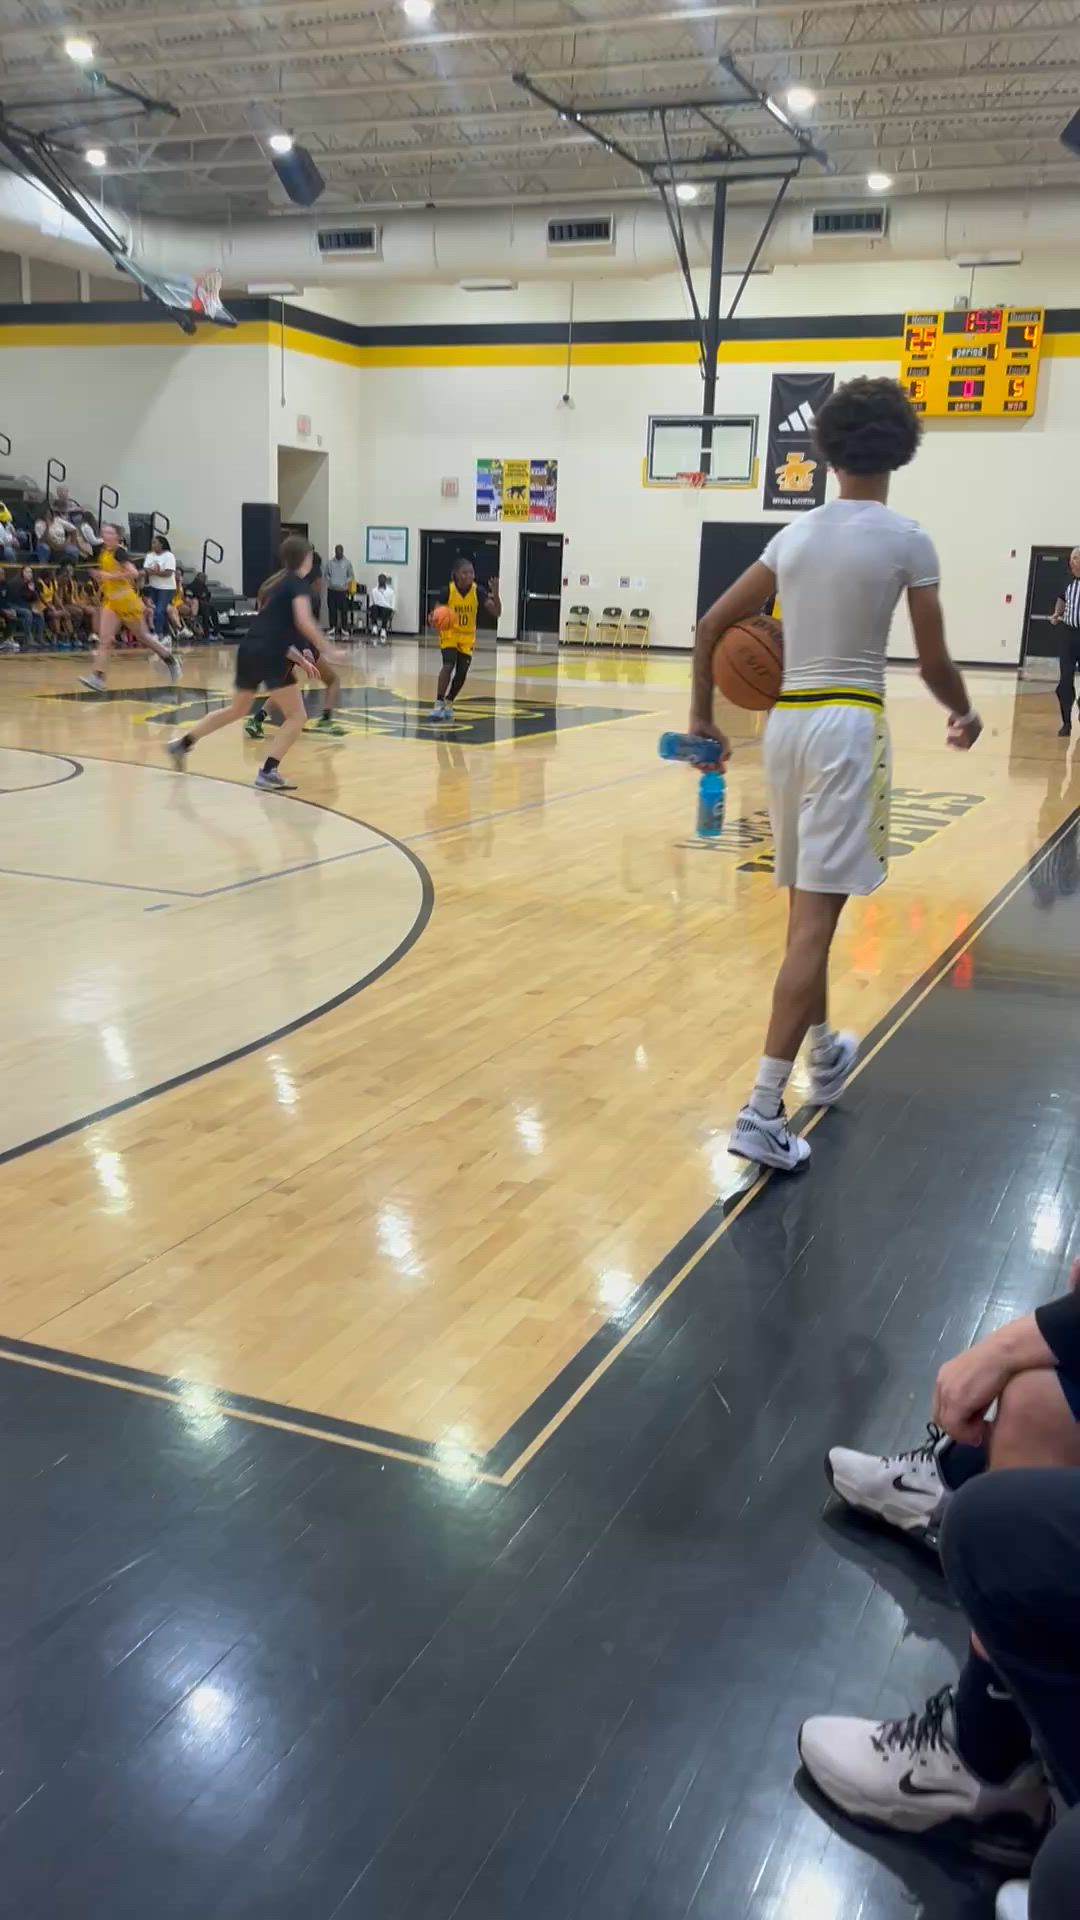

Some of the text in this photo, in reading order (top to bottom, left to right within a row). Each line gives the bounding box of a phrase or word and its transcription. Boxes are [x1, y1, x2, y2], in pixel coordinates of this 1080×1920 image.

[910, 327, 937, 350] 25
[1024, 325, 1039, 348] 4
[956, 347, 983, 359] period
[915, 381, 924, 398] 3
[963, 380, 974, 399] 0
[1013, 379, 1023, 397] 5
[459, 615, 468, 625] 10
